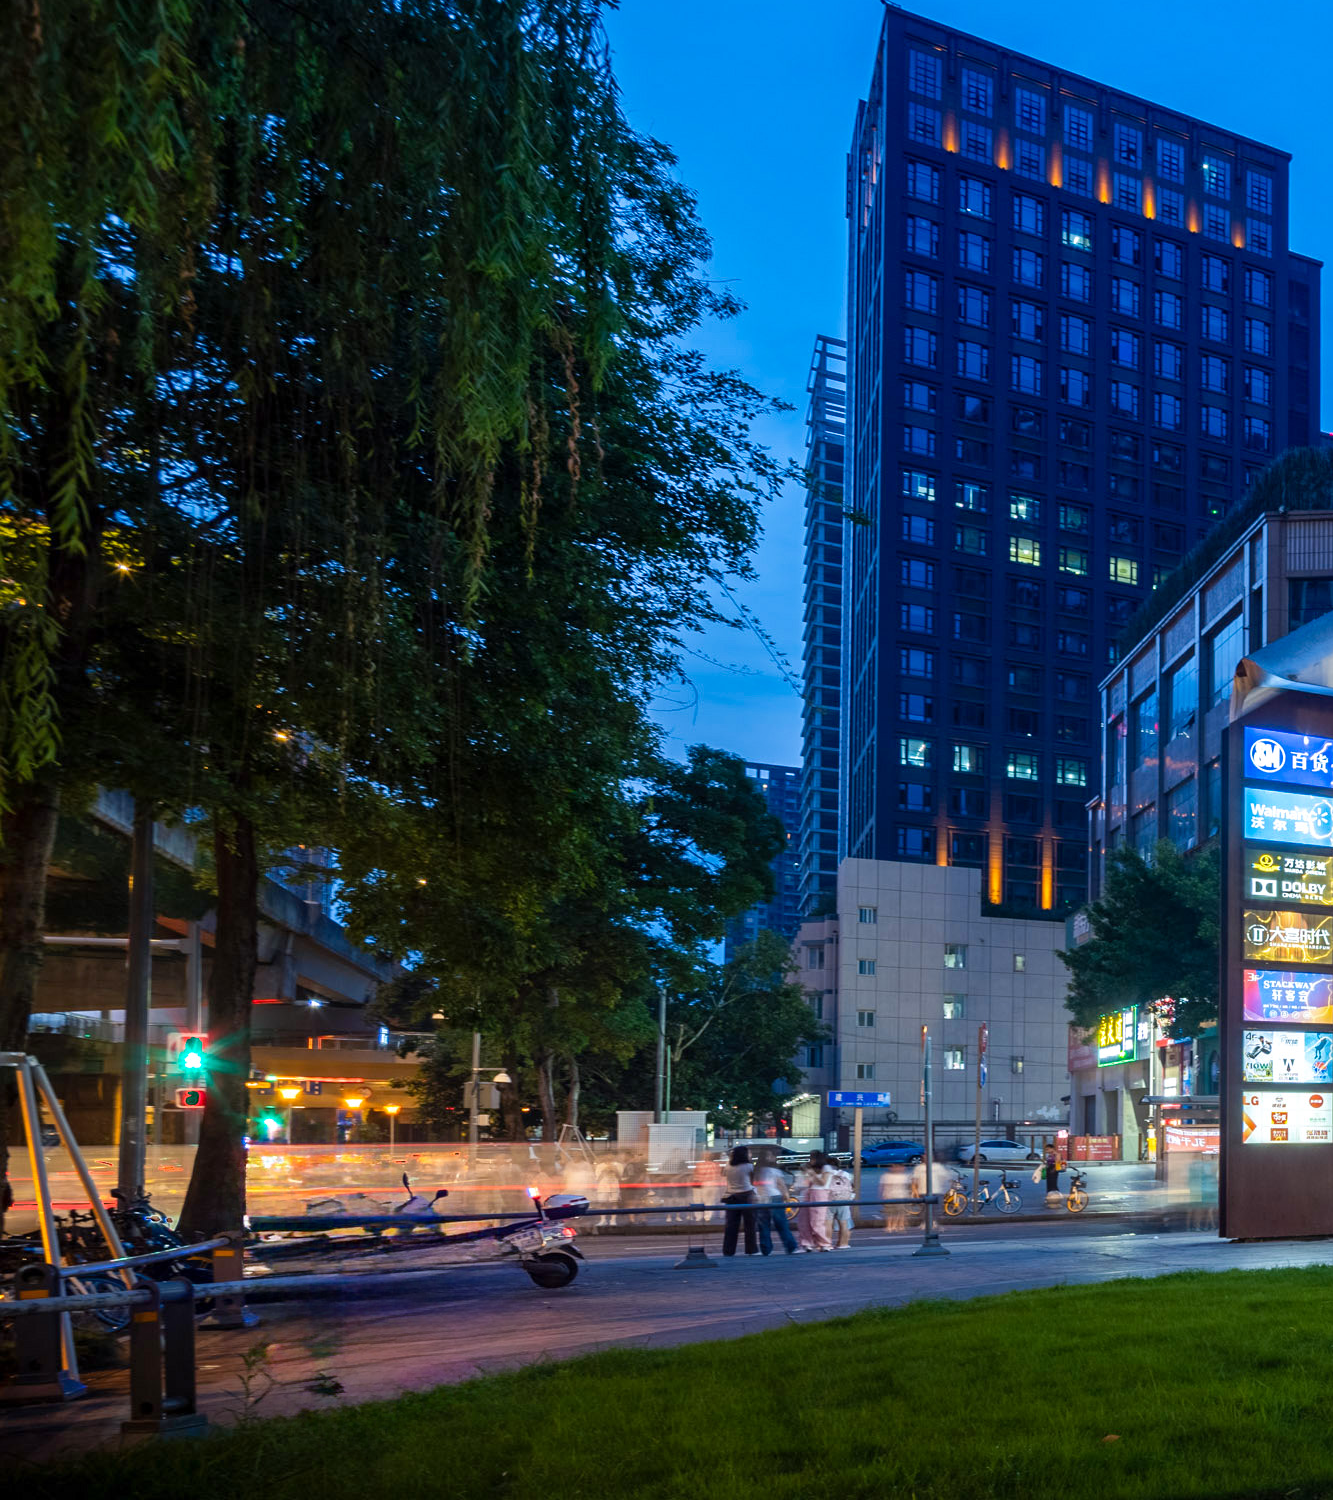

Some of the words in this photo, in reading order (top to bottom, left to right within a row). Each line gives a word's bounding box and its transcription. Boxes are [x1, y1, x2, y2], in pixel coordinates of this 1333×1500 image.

[1253, 741, 1281, 769] SM
[1290, 751, 1329, 773] 百货
[1250, 802, 1312, 822] Walmart
[1282, 880, 1327, 895] DOLBY
[1269, 926, 1331, 946] 大喜时代
[1263, 980, 1316, 991] STACKWAY
